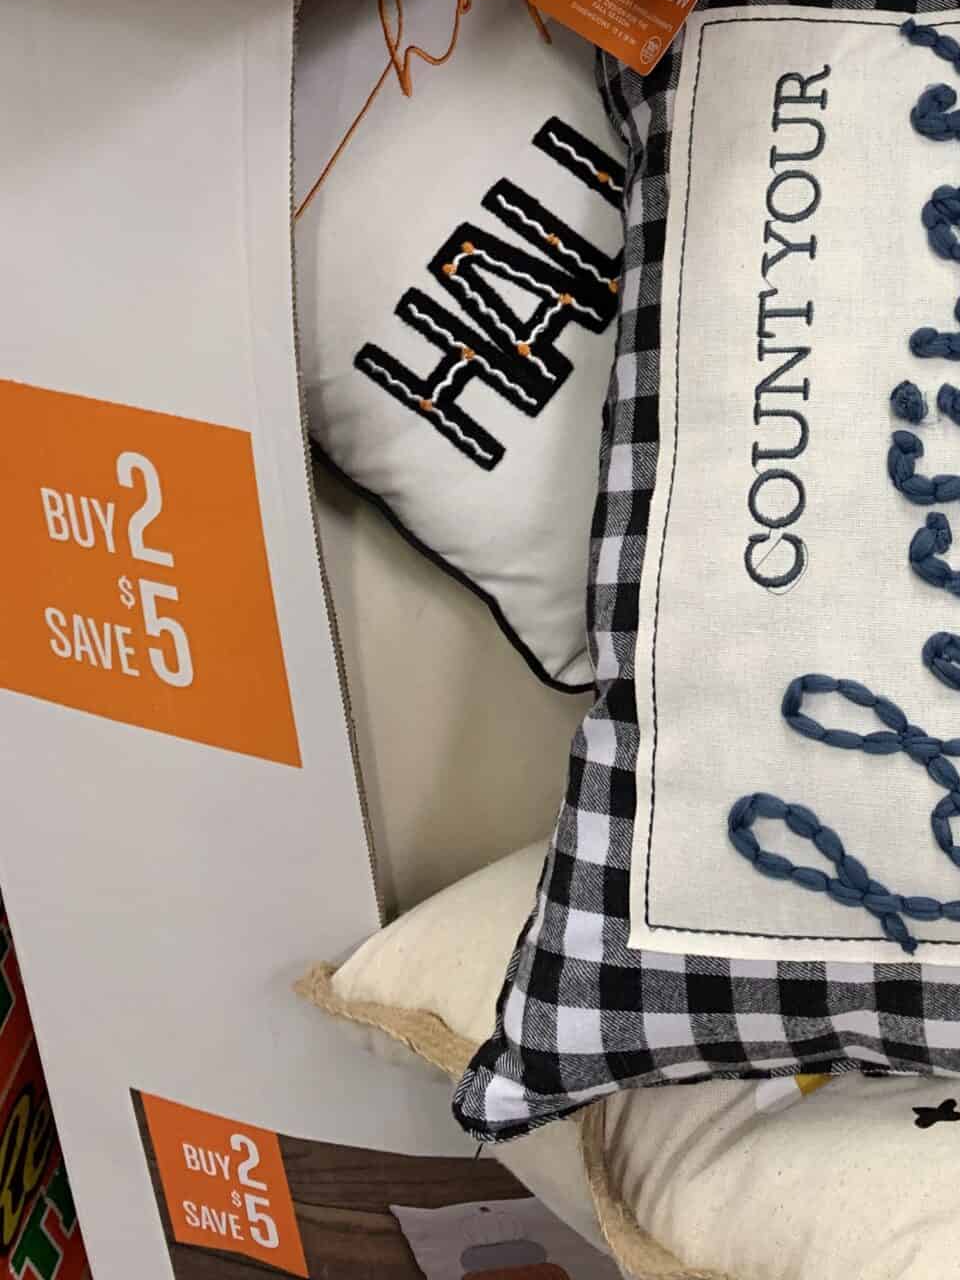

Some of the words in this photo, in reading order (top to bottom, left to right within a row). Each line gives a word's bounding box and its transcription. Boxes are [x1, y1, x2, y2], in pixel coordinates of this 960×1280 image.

[761, 64, 831, 278] YOUR
[744, 287, 814, 589] COUNT
[40, 487, 116, 553] BUY
[116, 451, 175, 568] 2
[44, 607, 140, 677] SAVE
[183, 1143, 230, 1180] BUY
[230, 1134, 268, 1191] 2
[183, 1200, 244, 1240] SAVE
